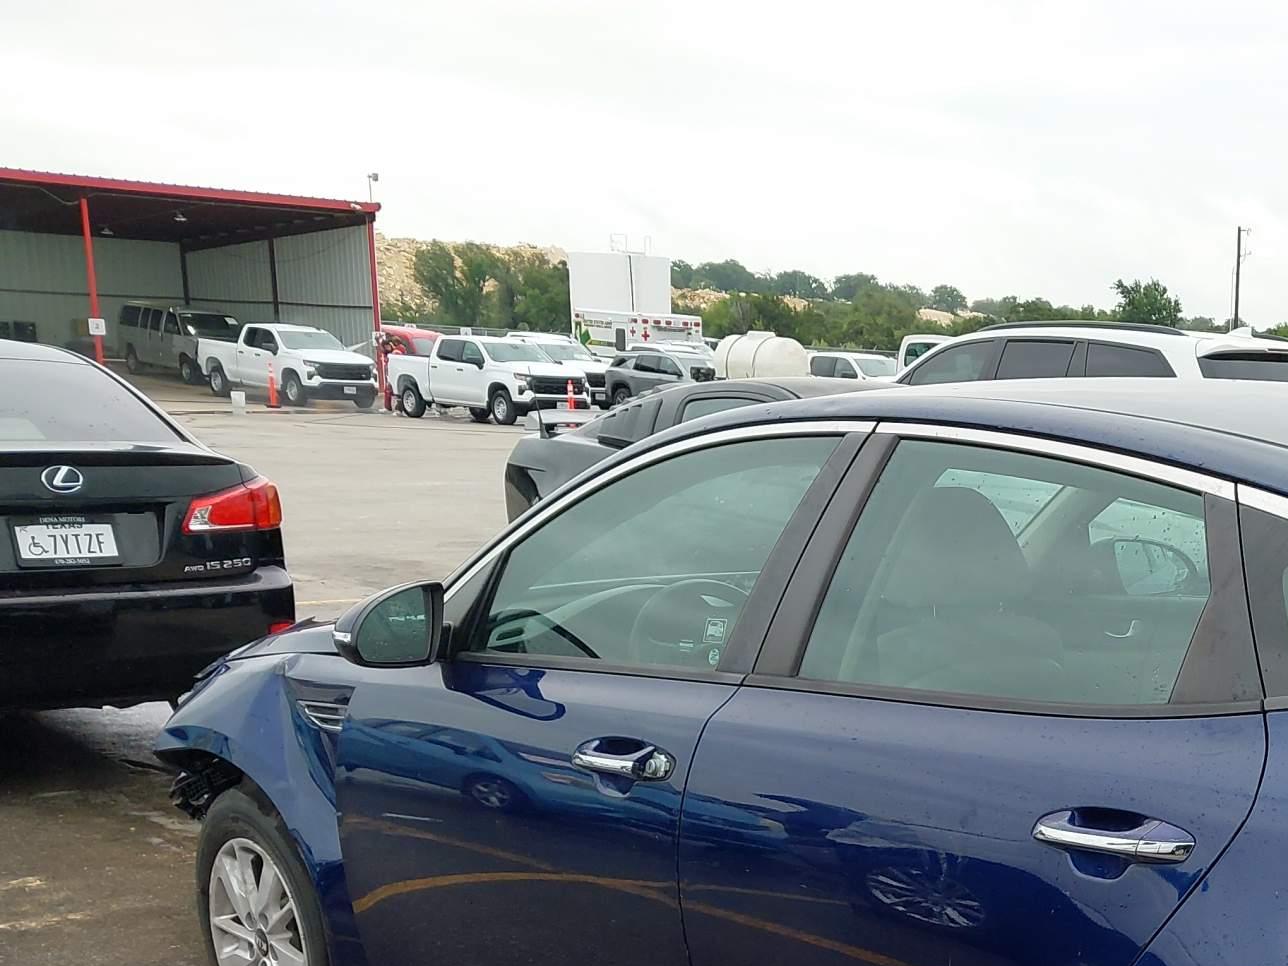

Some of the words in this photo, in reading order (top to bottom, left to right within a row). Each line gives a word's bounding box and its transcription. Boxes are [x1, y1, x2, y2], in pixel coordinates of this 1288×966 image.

[47, 533, 105, 555] 7YTZF
[183, 565, 205, 573] AWD
[205, 561, 221, 570] IS
[223, 557, 252, 569] 250
